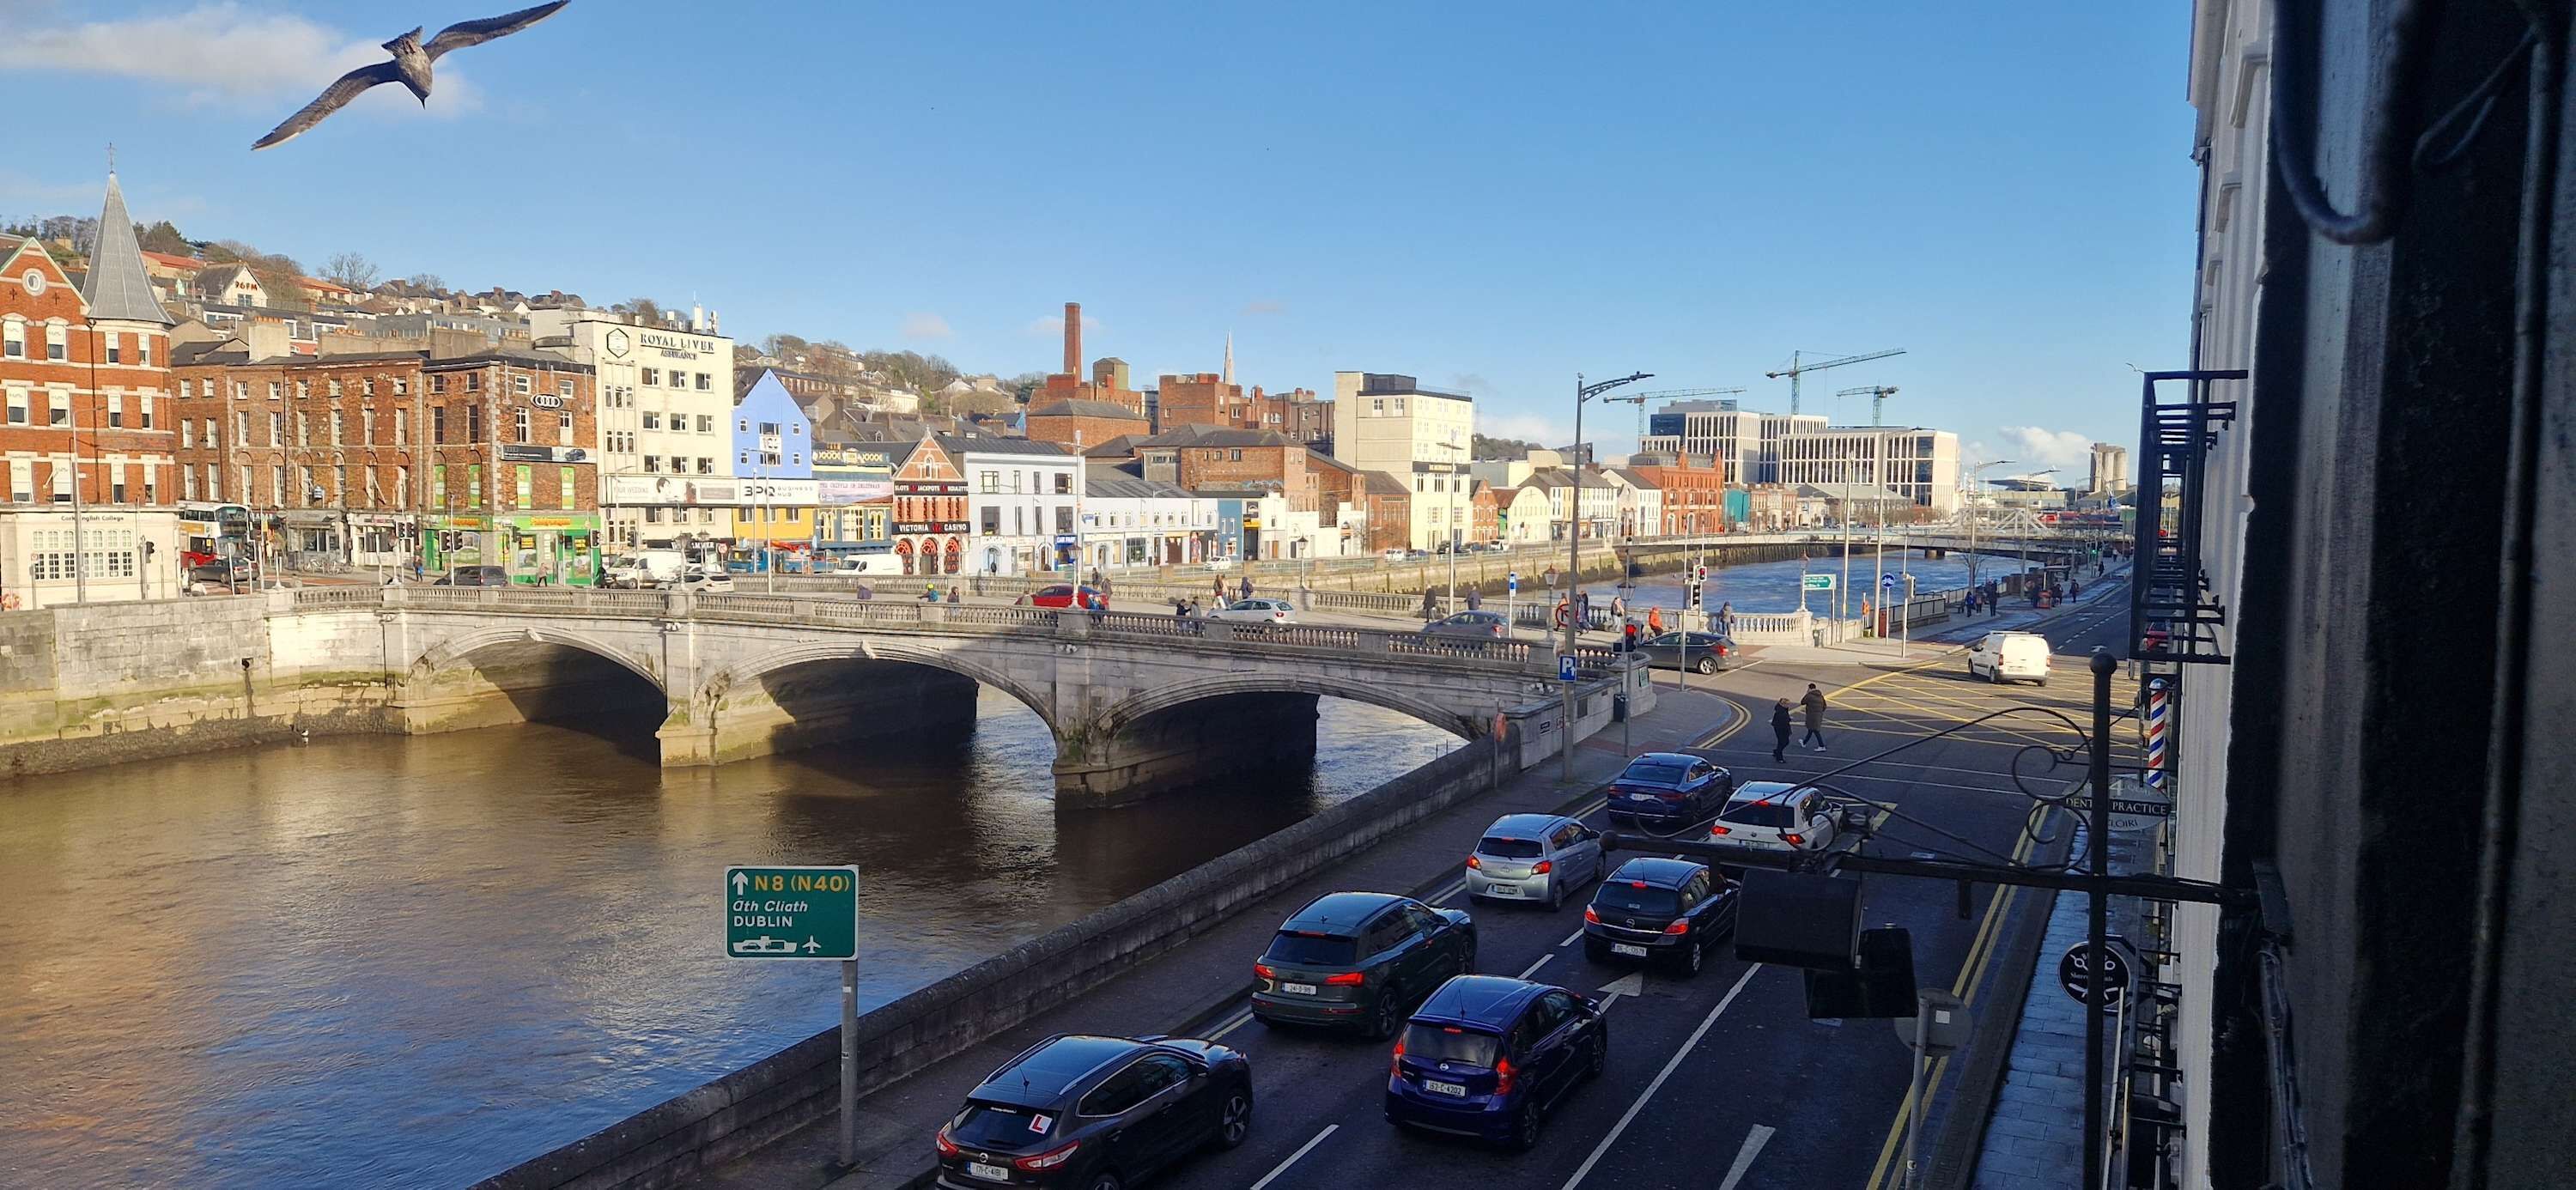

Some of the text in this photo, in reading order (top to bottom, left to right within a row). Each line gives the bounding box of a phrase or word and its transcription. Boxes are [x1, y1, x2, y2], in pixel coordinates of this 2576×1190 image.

[641, 333, 714, 351] ROYAL LIVER
[1562, 657, 1574, 674] P
[2112, 801, 2166, 815] PRACTICE
[755, 874, 850, 892] N8 (N40)
[764, 900, 808, 912] Cliath
[733, 915, 793, 927] DUBLIN
[1032, 1115, 1043, 1132] L
